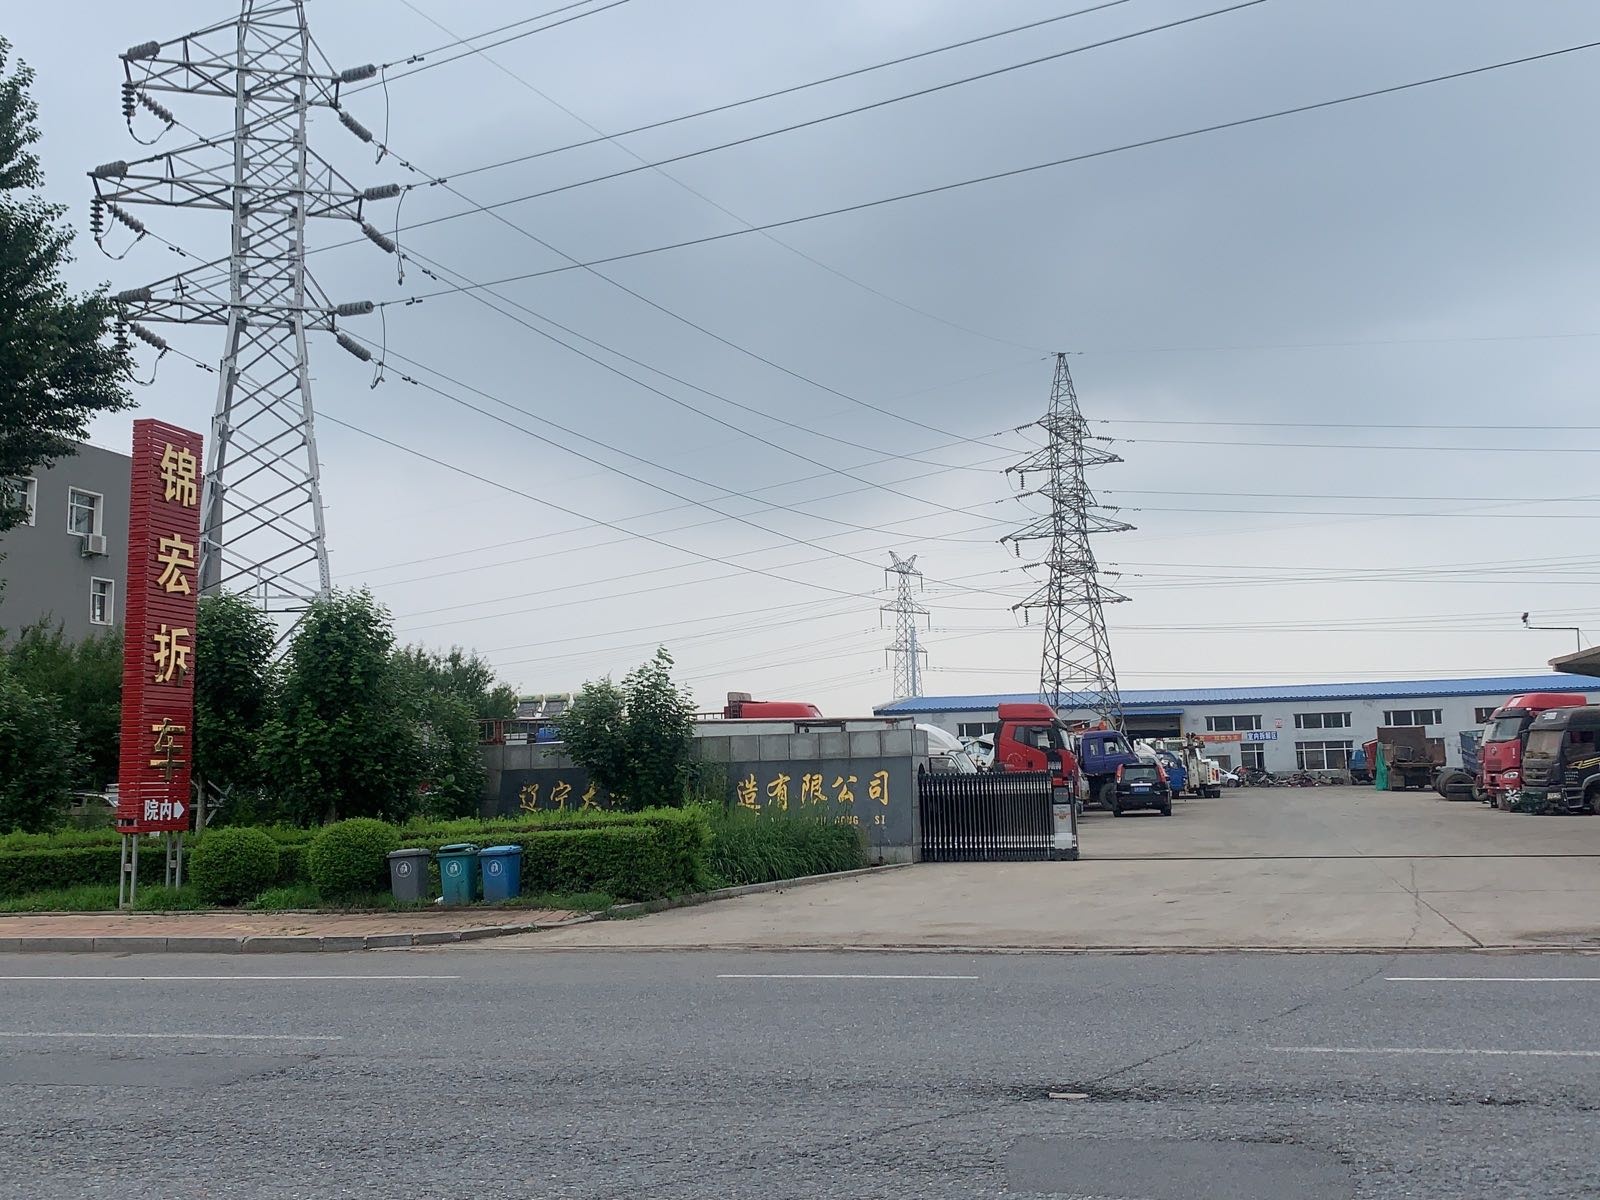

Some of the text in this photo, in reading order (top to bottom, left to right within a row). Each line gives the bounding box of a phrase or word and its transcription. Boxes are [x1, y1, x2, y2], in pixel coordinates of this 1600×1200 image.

[150, 443, 197, 781] 锦宏拆车
[737, 770, 889, 811] 造有限公司
[144, 799, 172, 821] 院内
[874, 814, 886, 825] SI
